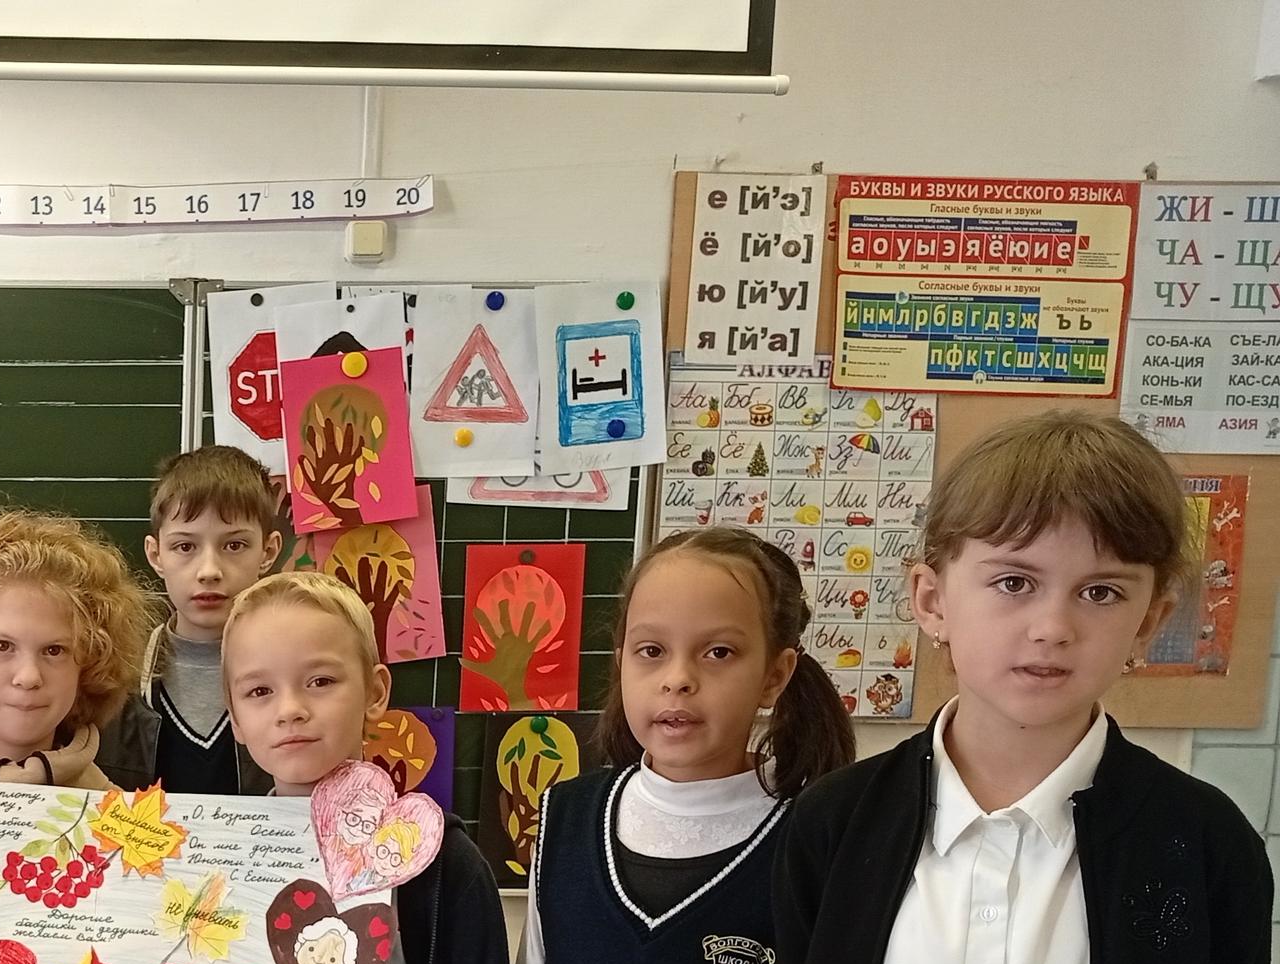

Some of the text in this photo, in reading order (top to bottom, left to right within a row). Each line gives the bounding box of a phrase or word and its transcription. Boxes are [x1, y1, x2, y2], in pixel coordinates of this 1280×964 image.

[31, 196, 53, 215] 13
[83, 196, 106, 215] 14
[134, 197, 157, 215] 15
[186, 195, 209, 214] 16
[238, 193, 261, 212] 17
[292, 191, 314, 209] 18
[344, 189, 366, 208] 19
[397, 187, 420, 205] 20
[708, 189, 727, 209] е
[850, 181, 1124, 202] БУКВЫ И ЗВУКИ РУССКОГО ЯЗЫКА
[930, 203, 970, 214] Гласные
[972, 204, 1003, 217] буквы
[1014, 207, 1042, 217] звуки
[1155, 195, 1280, 223] ЖИ Ш
[699, 231, 719, 256] ё
[1156, 239, 1203, 265] ЧА
[697, 283, 726, 303] ю
[919, 281, 970, 292] Согласные
[972, 282, 1003, 294] буквы
[1014, 285, 1041, 294] звуки
[1154, 281, 1200, 308] ЧУ
[697, 331, 716, 349] я
[1146, 335, 1212, 348] СО-БА-КА
[738, 361, 832, 378] АЛФАВ
[1142, 356, 1204, 369] АКА-ЦИЯ
[237, 368, 279, 405] ST
[1142, 375, 1202, 388] КОНЬ-КИ
[1228, 375, 1280, 386] КАС-СА
[671, 383, 708, 408] Аа
[724, 383, 761, 408] Бб
[779, 385, 809, 409] Вв
[1140, 394, 1193, 406] СЕ-МЬЯ
[1226, 394, 1280, 409] ПО-ЕЗД
[1155, 416, 1258, 430] ЯМА АЗИЯ
[667, 432, 692, 458] Ее
[720, 430, 746, 458] Ёё
[829, 434, 854, 470] Зз
[883, 435, 912, 460] Ии
[716, 481, 745, 507] Кк
[771, 482, 806, 507] Лл
[825, 482, 868, 508] Мм
[878, 482, 914, 508] Нн
[110, 804, 174, 837] внимания
[211, 807, 271, 826] возраст
[101, 824, 170, 851] от внуков
[189, 836, 304, 859] Он мне дороже
[187, 853, 245, 866] Юности
[244, 870, 289, 883] Есенин
[48, 909, 114, 923] Дорогие
[165, 902, 184, 915] не
[12, 928, 72, 940] желаем
[15, 918, 77, 932] бабушки
[97, 926, 160, 939] дедушки
